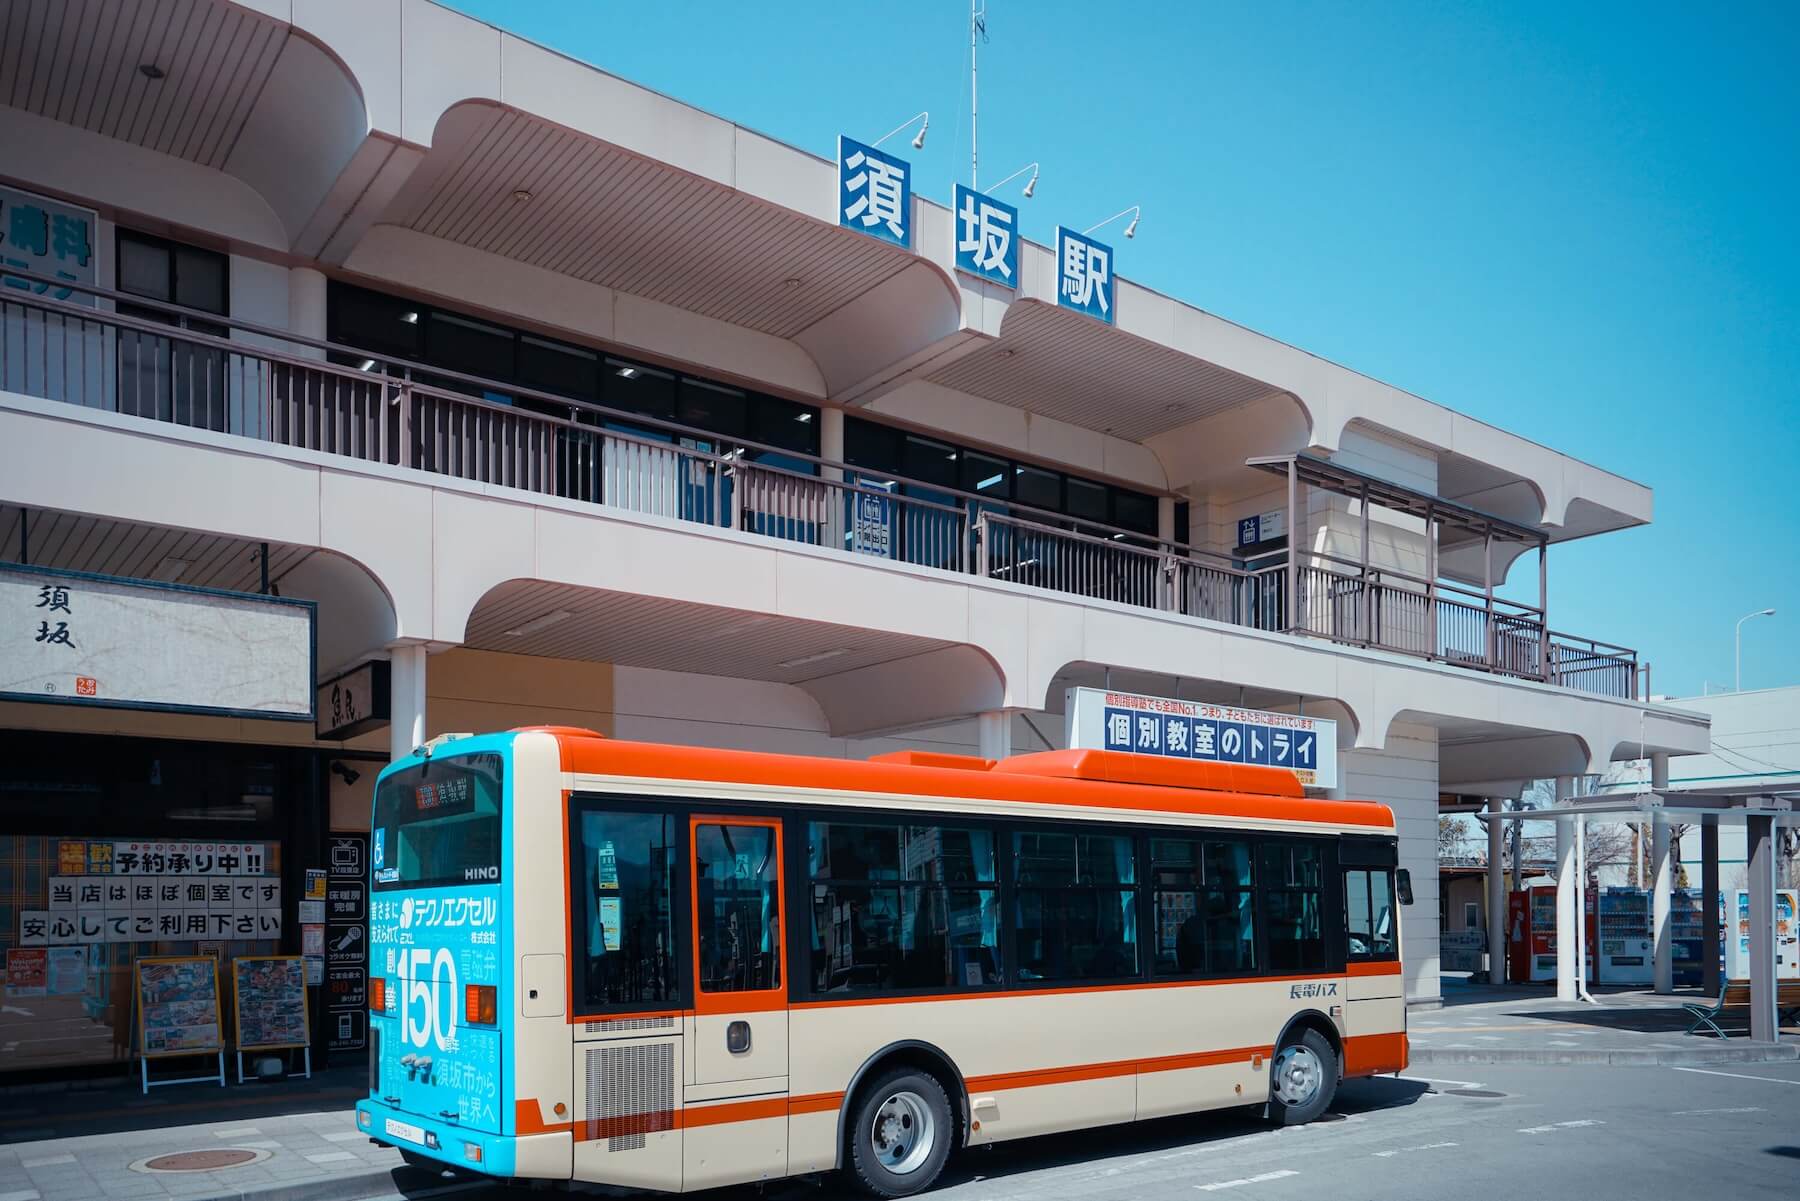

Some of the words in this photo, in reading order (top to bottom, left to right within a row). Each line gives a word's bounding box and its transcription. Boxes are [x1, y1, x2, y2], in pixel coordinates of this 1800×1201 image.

[845, 150, 905, 240] 須
[958, 194, 1012, 279] 坂
[1062, 235, 1110, 313] 駅
[35, 584, 76, 649] 須坂
[1108, 713, 1313, 764] 個別教室のトライ
[464, 866, 499, 881] HINO
[52, 883, 279, 904] 当店はほぼ個室です
[415, 896, 497, 927] テクノエクセル
[23, 916, 280, 939] 安心してご利用下さい
[470, 931, 497, 945] 株式会社
[397, 947, 459, 1052] 150
[1290, 982, 1337, 999] 長電バス
[436, 1058, 497, 1099] 須坂市から
[458, 1095, 496, 1124] 世界へ
